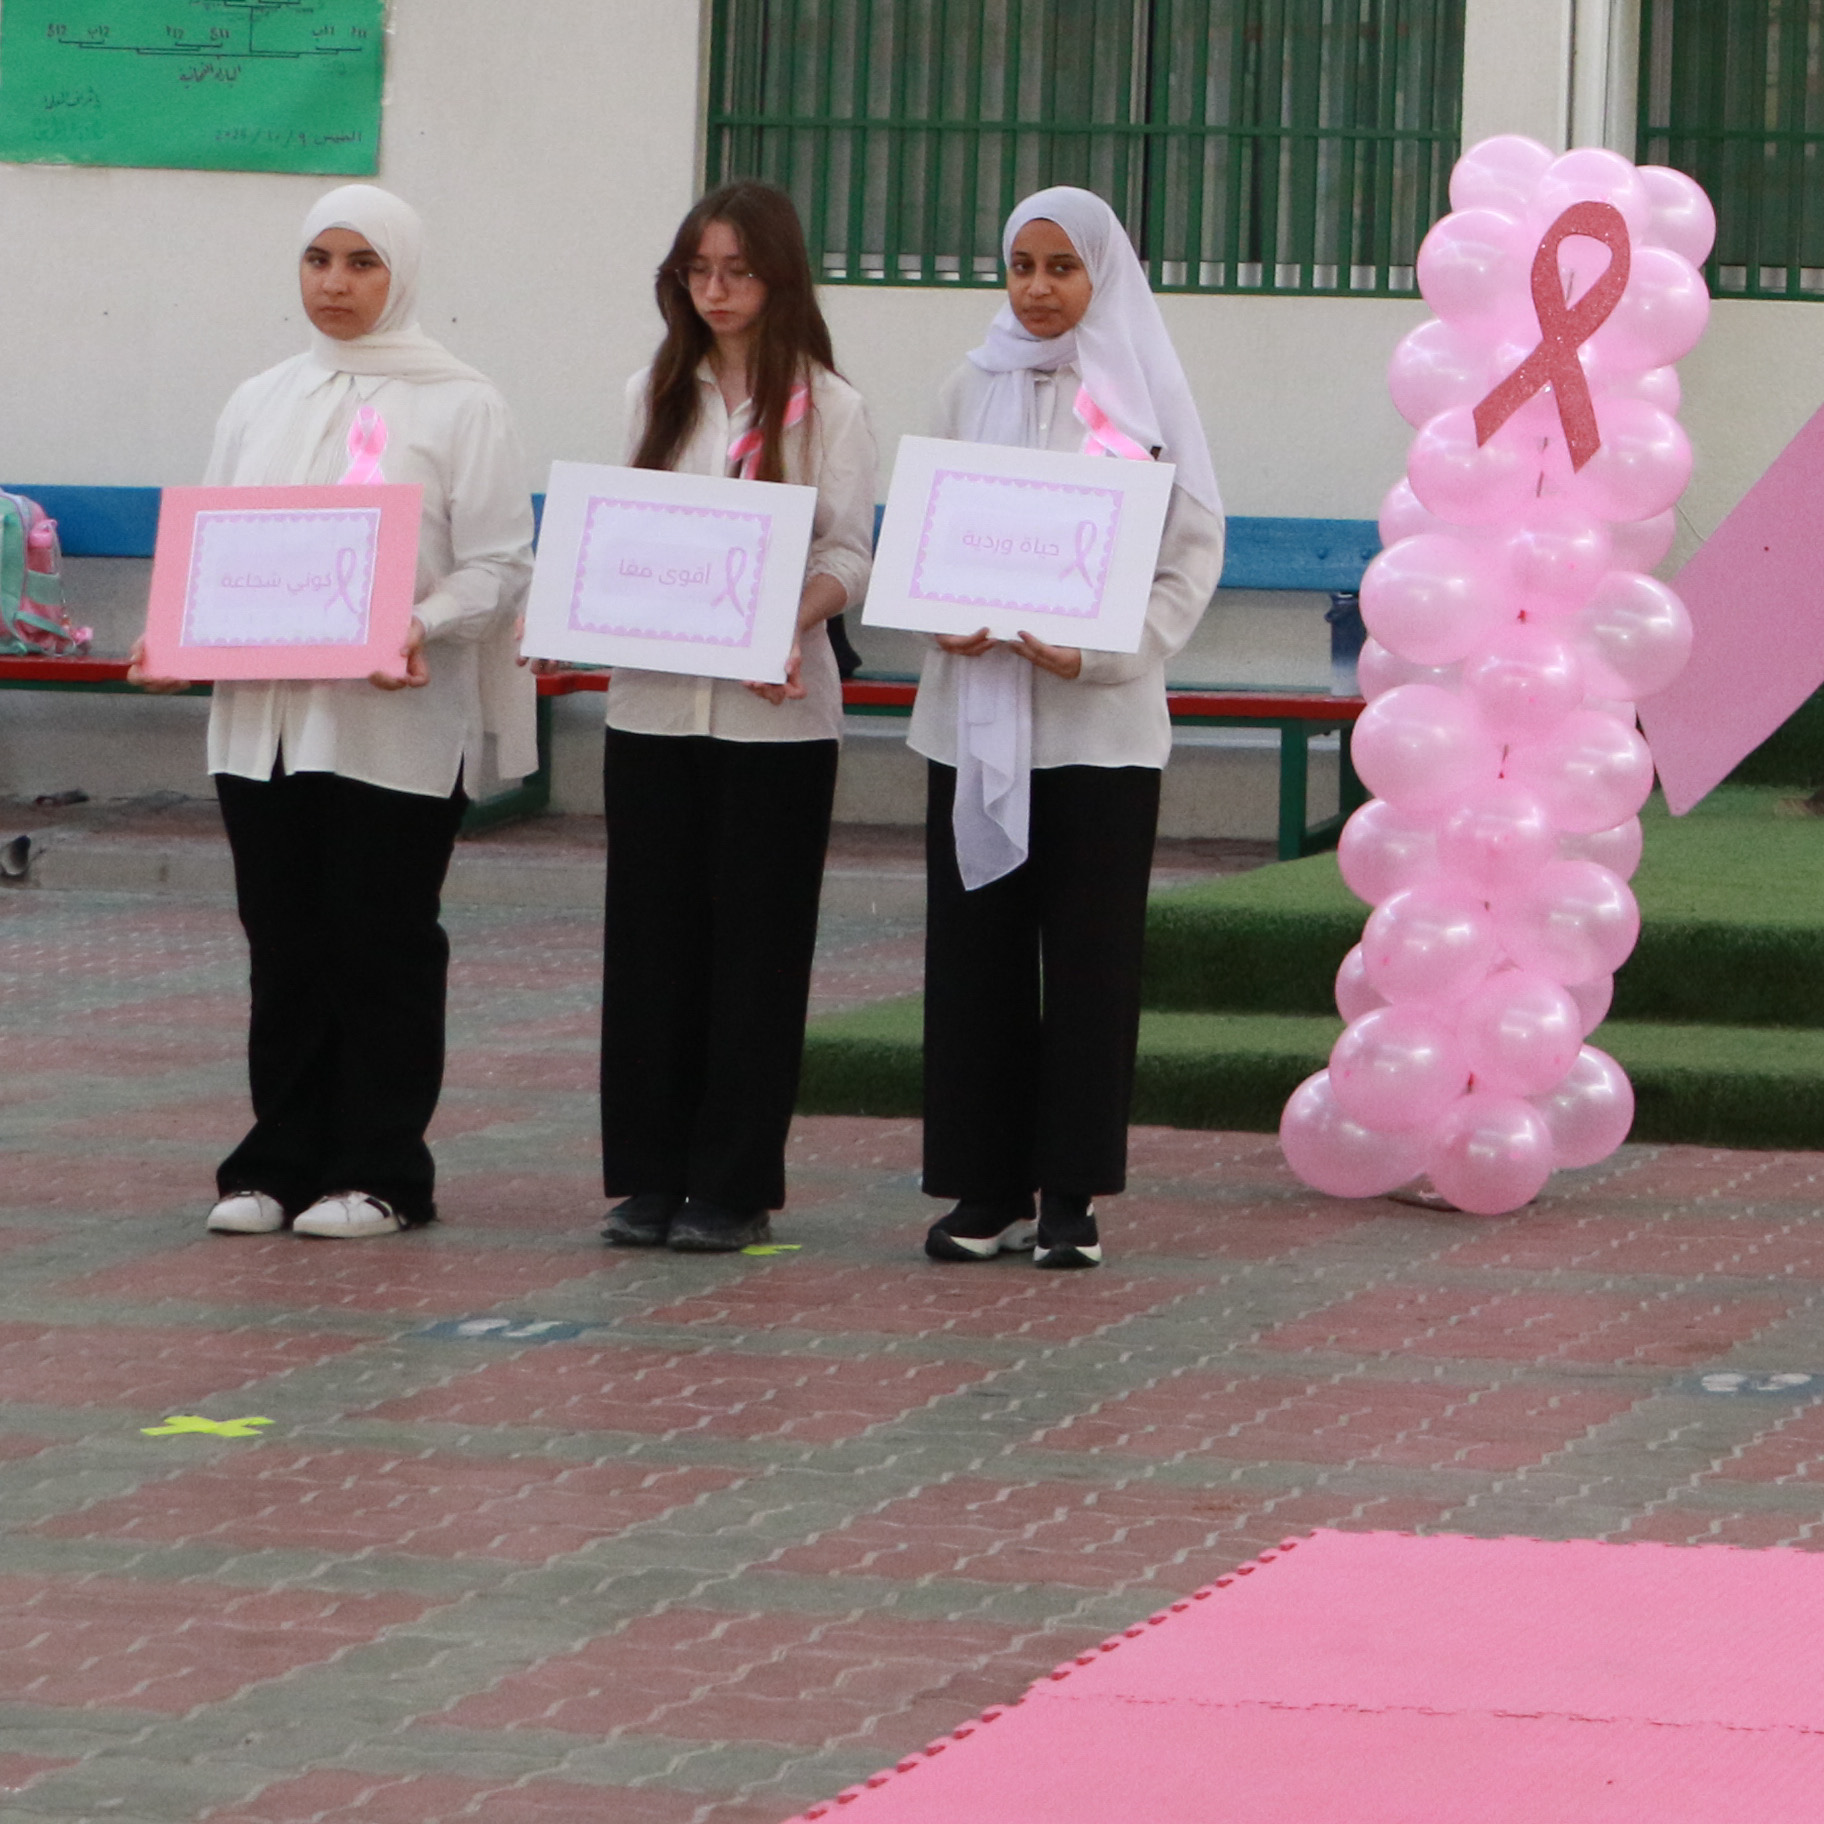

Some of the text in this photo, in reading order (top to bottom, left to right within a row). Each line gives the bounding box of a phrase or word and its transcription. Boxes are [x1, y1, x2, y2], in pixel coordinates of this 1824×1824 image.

[961, 528, 1061, 558] حياة وردية
[285, 570, 333, 596] كوني
